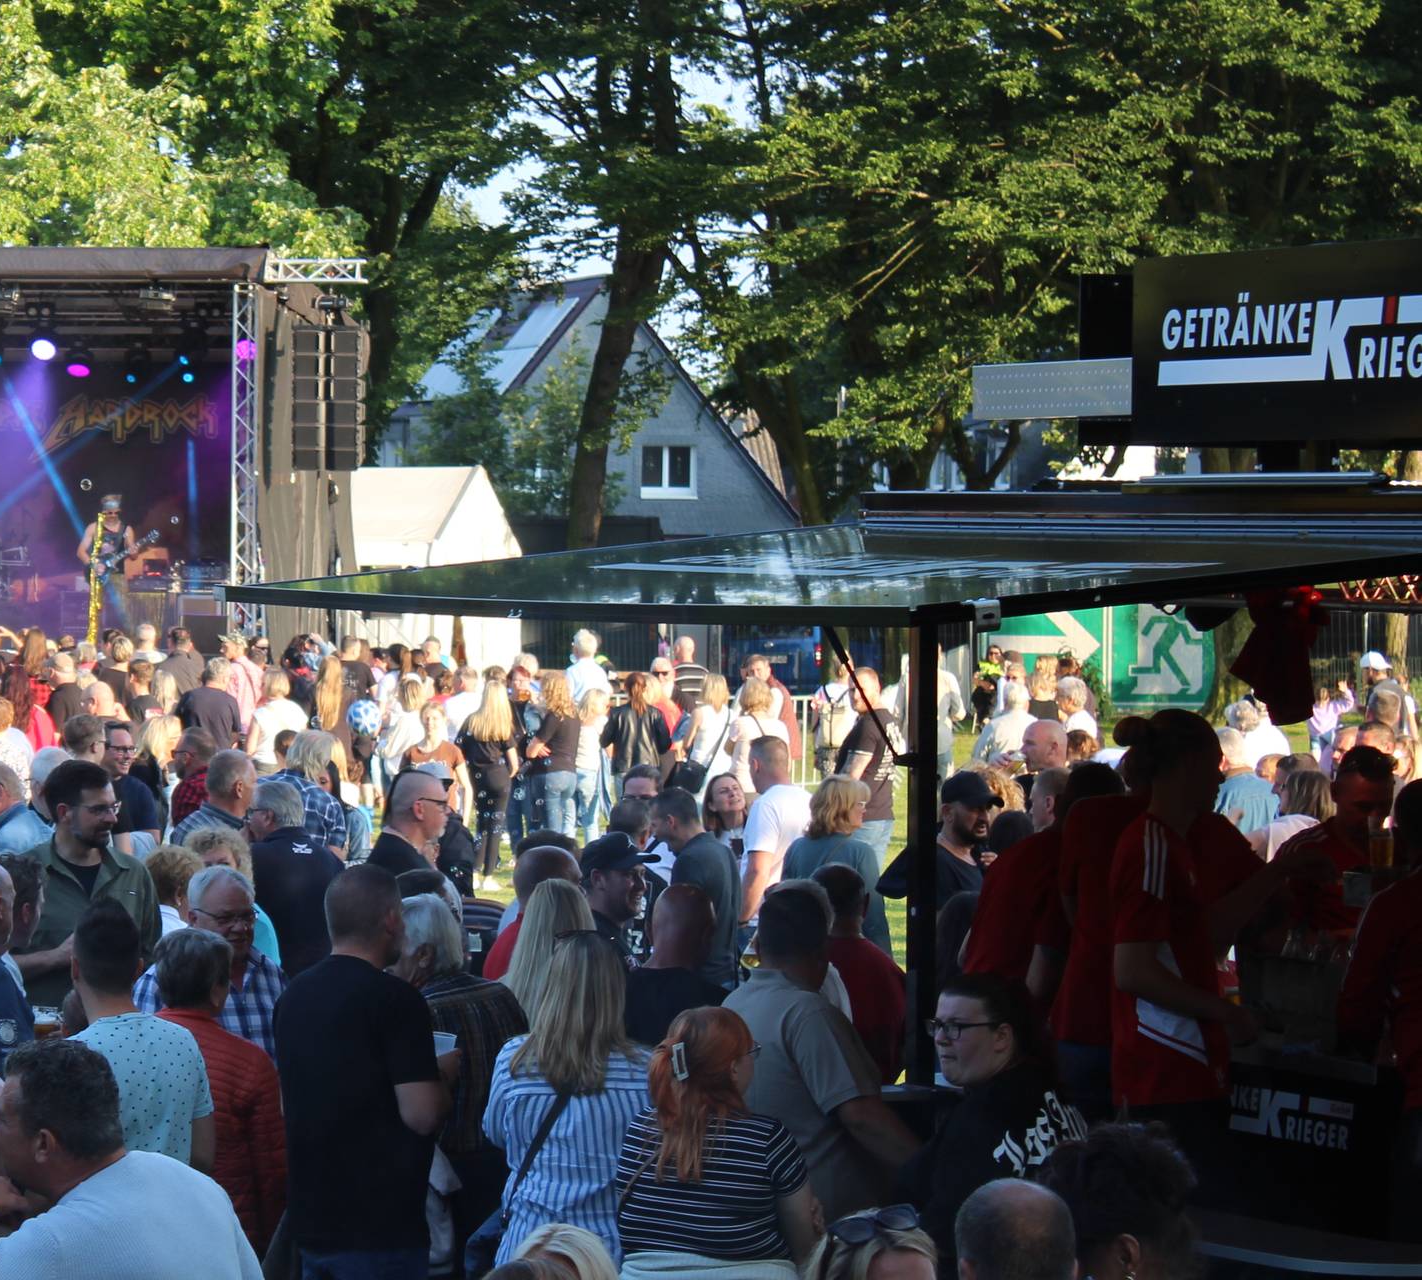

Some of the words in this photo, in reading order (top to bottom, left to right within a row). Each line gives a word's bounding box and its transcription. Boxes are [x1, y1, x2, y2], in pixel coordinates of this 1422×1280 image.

[1161, 291, 1313, 350] GETRÄNKE
[29, 393, 220, 463] HARDROCK
[1258, 1087, 1350, 1151] KRIEGER
